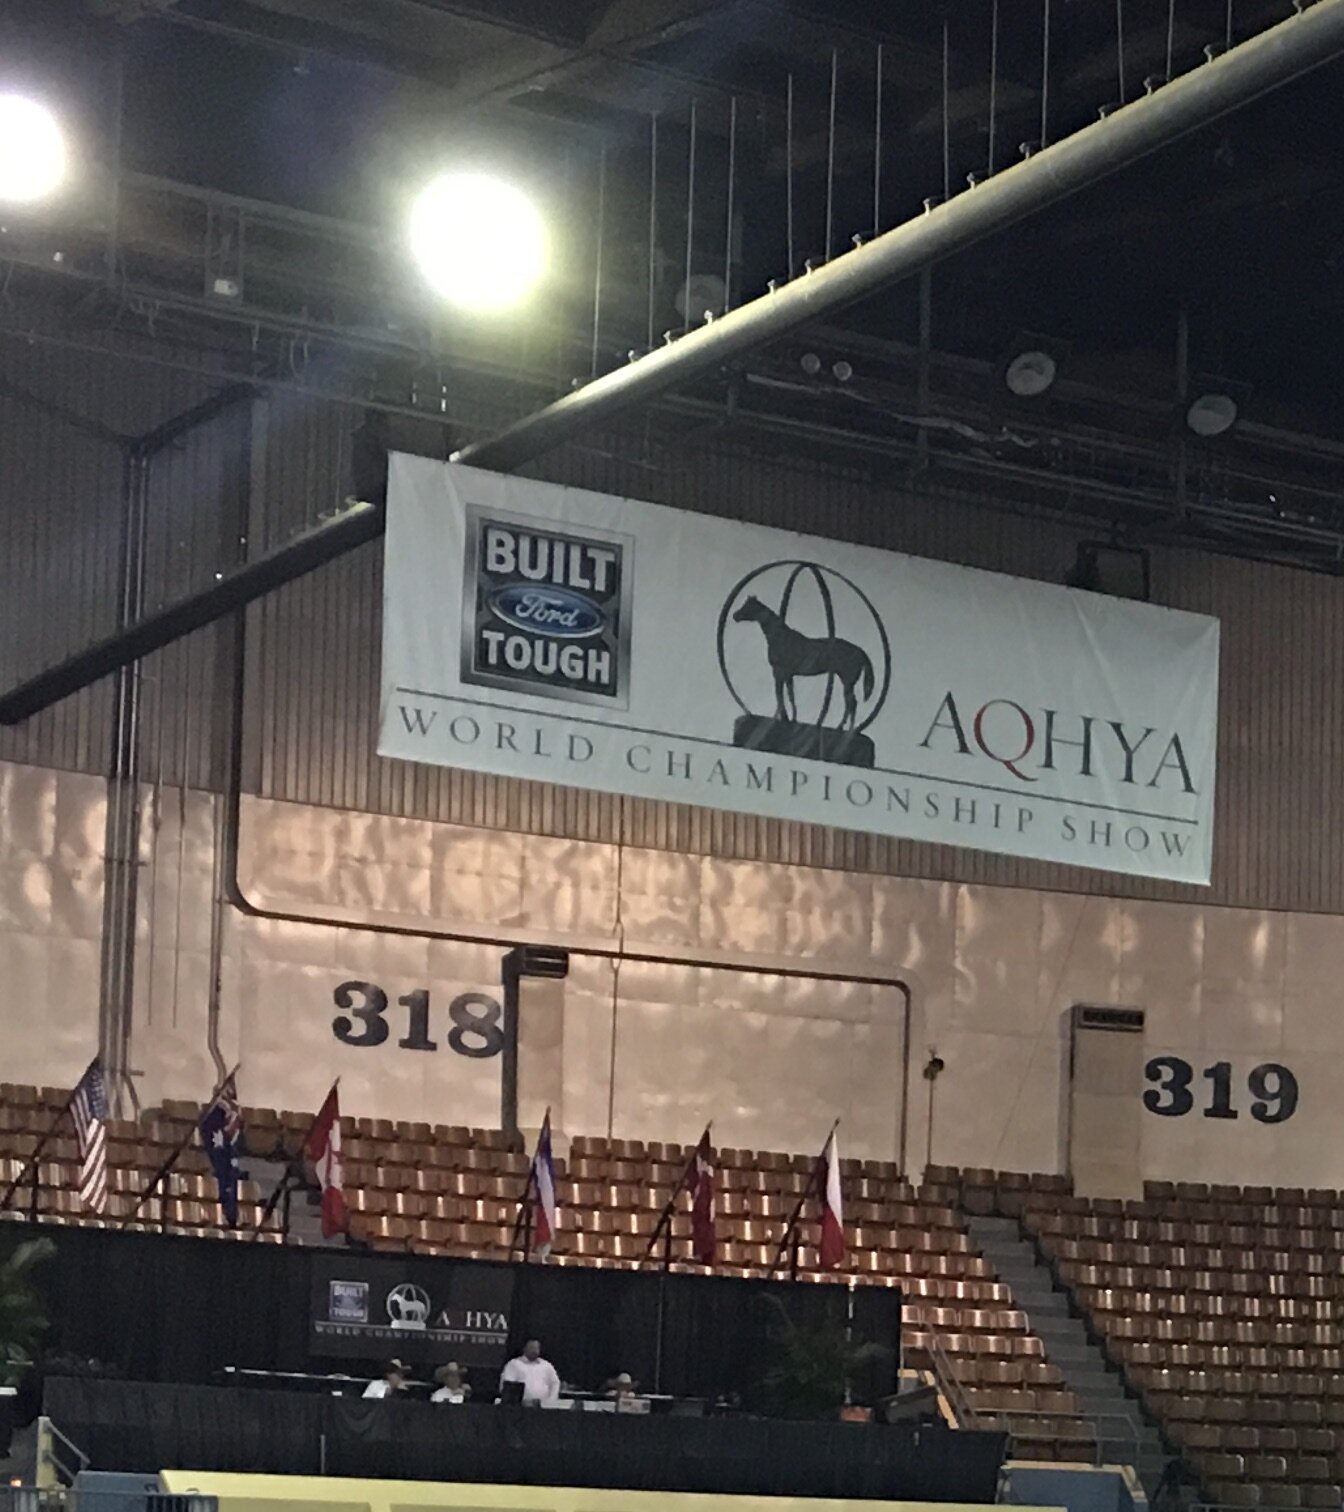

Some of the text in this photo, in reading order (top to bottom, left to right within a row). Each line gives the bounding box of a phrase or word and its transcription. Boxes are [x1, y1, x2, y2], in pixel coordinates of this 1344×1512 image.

[486, 528, 615, 592] BUILT
[514, 593, 580, 627] Ford
[482, 630, 611, 685] TOUGH
[918, 691, 1199, 794] AQHYA
[400, 705, 1192, 858] WORLD CHAMPIONSHIP SHOW
[332, 981, 504, 1058] 318
[1142, 1057, 1299, 1124] 319
